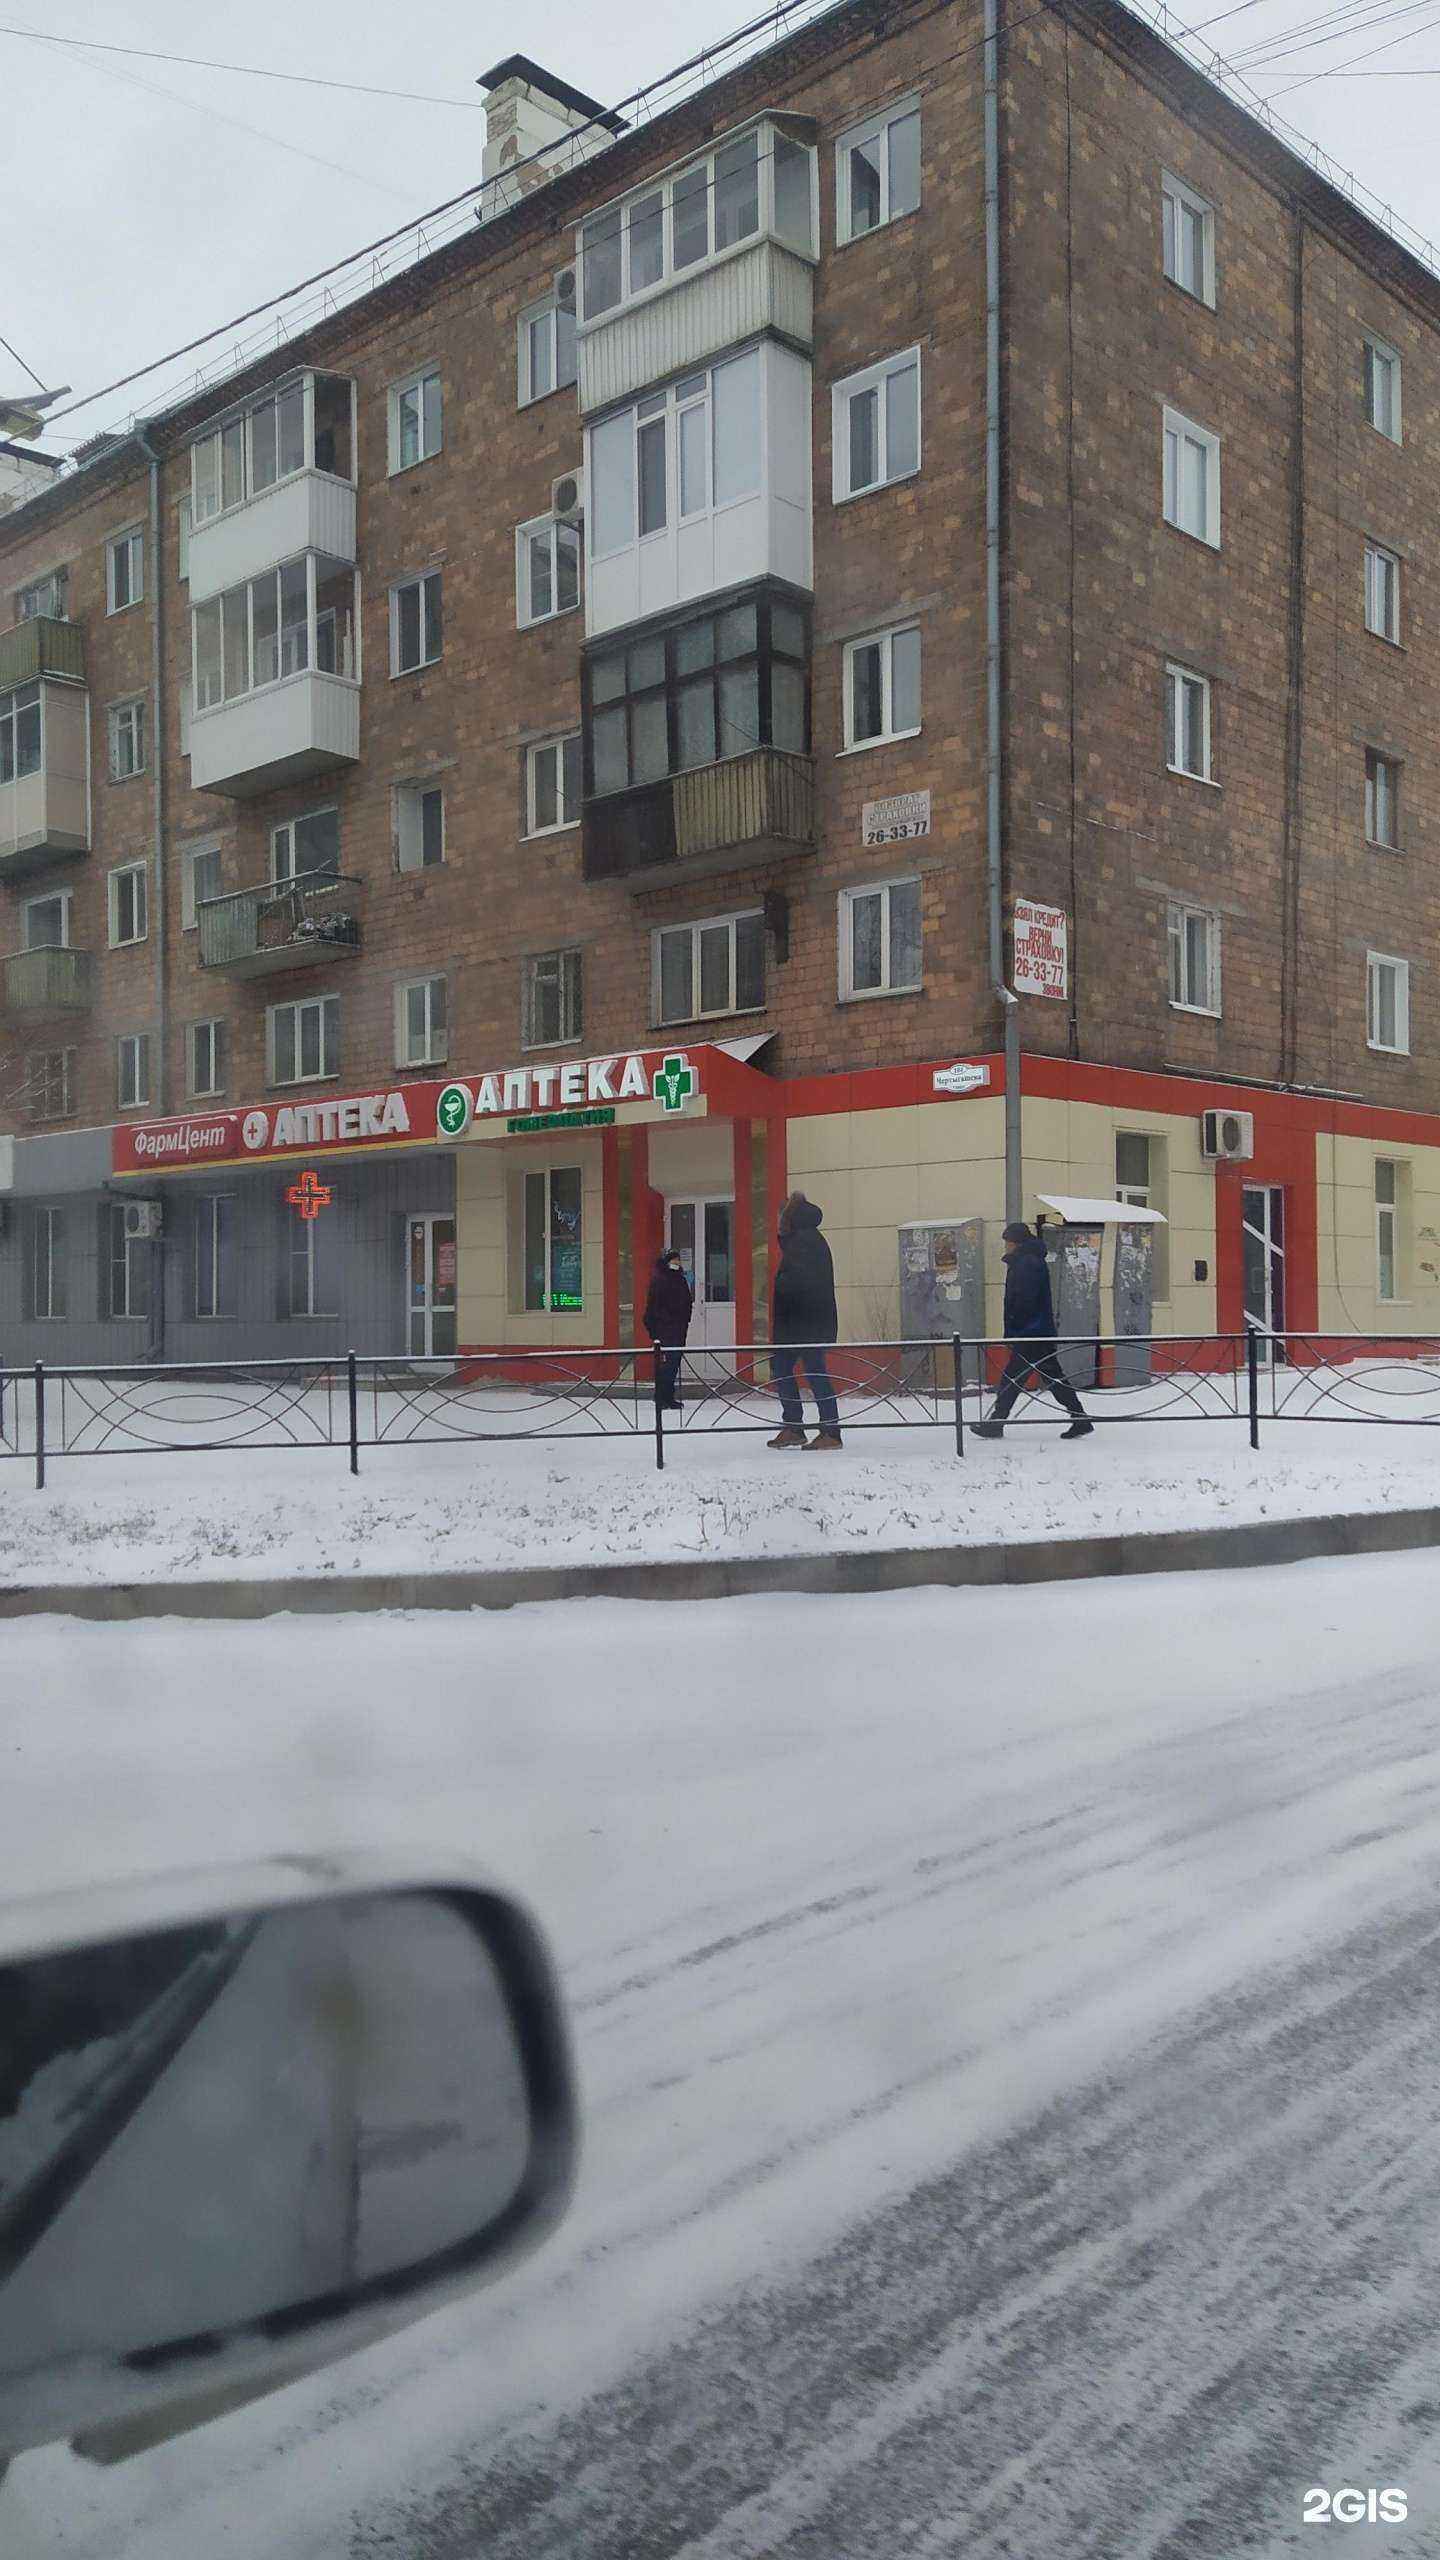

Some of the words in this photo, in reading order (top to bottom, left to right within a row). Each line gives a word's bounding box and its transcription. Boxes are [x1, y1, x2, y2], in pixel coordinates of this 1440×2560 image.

[867, 820, 927, 845] 26-33-77
[1029, 926, 1052, 945] ВЕРНИ
[1016, 956, 1064, 985] 26-33-77
[474, 1056, 648, 1114] АПТЕКА
[272, 1092, 410, 1147] АПТЕКА
